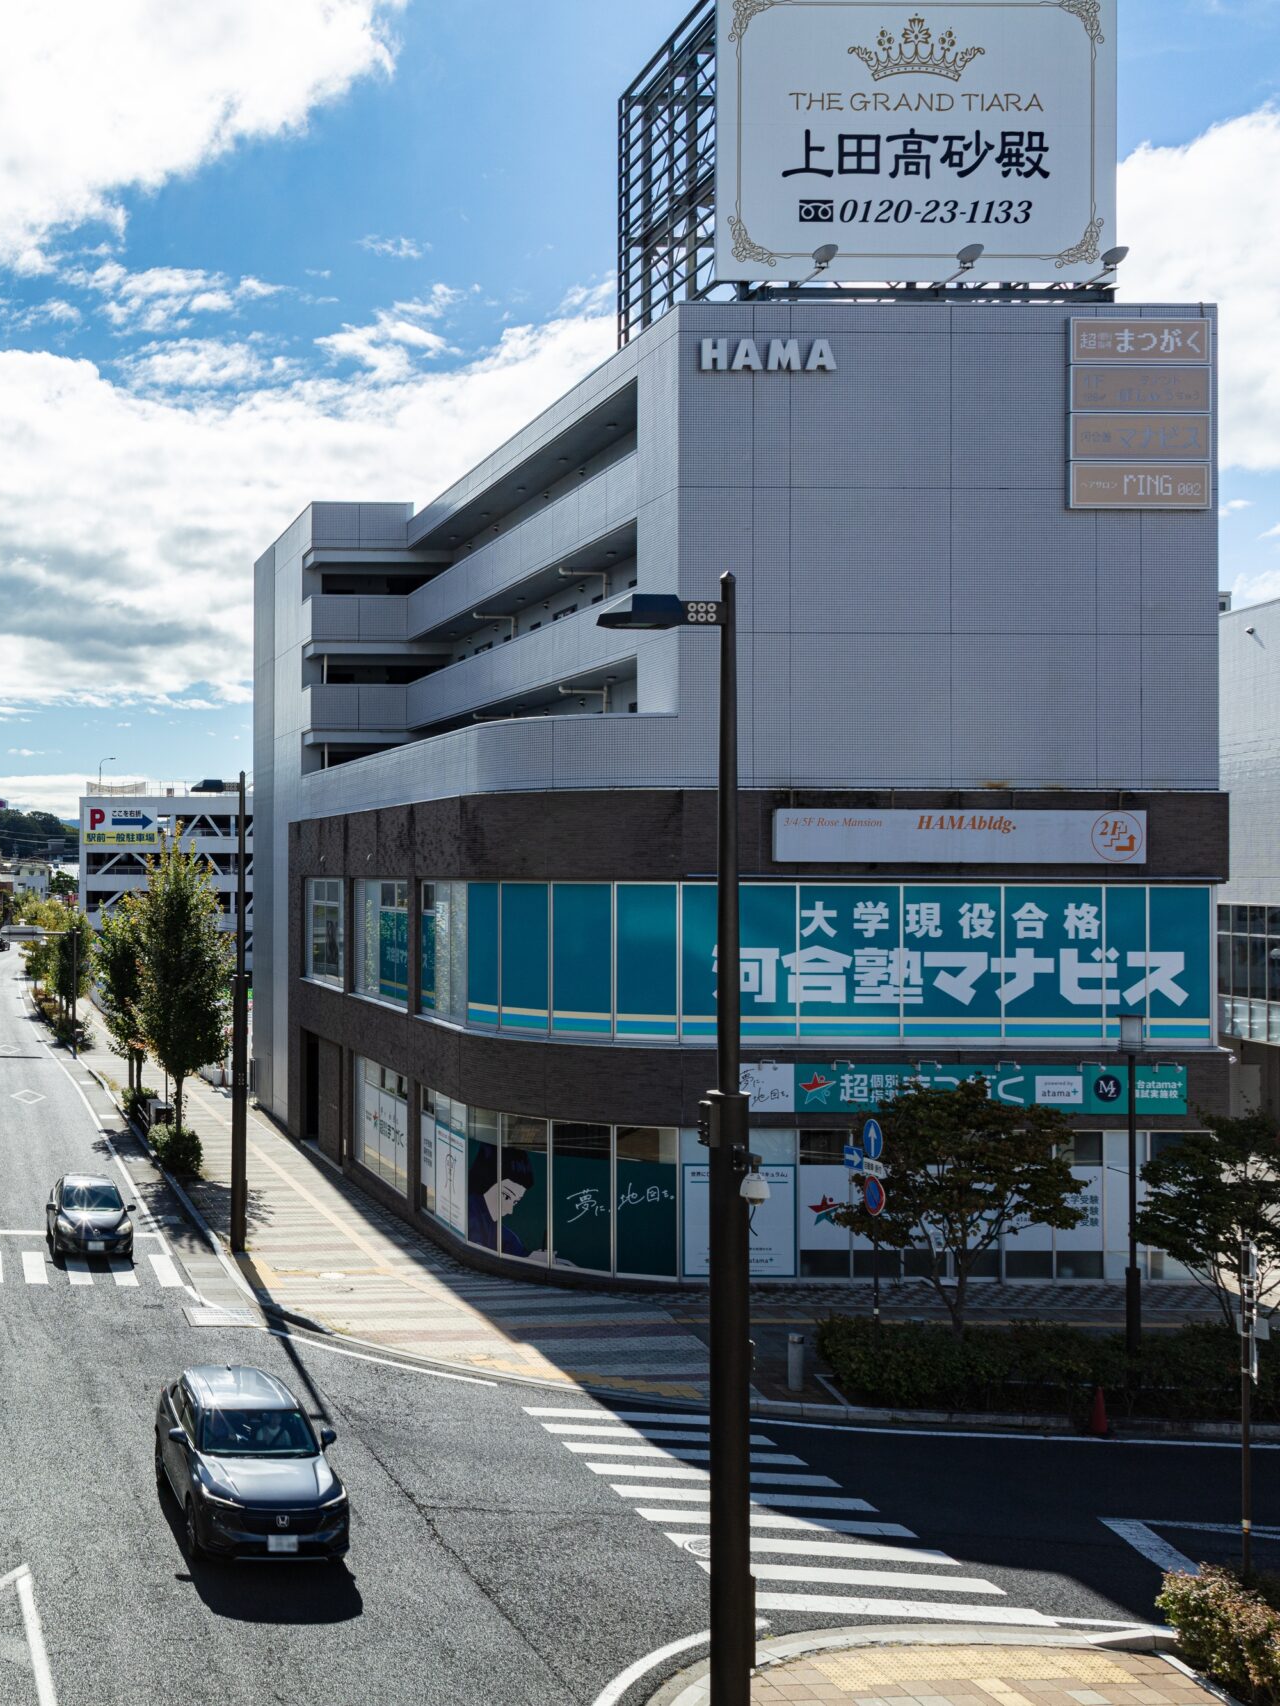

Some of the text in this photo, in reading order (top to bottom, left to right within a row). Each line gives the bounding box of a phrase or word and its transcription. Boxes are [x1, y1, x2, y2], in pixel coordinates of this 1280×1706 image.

[788, 92, 1044, 112] THE GRAND TIARA
[781, 128, 1050, 180] 上田高砂殿
[839, 199, 1033, 224] 0120-23-1133
[1115, 328, 1201, 354] まつがく
[700, 337, 838, 372] HAMA
[90, 808, 106, 831] P
[816, 817, 840, 828] Rose
[841, 818, 883, 829] Mansion
[916, 814, 1017, 834] HAMAbldg.
[1099, 820, 1124, 836] 2F
[86, 832, 155, 843] 駅前一般駐車場
[800, 901, 1101, 940] 大学現役合格
[711, 944, 1190, 1007] 河合塾マナビス
[839, 1074, 869, 1102] 超
